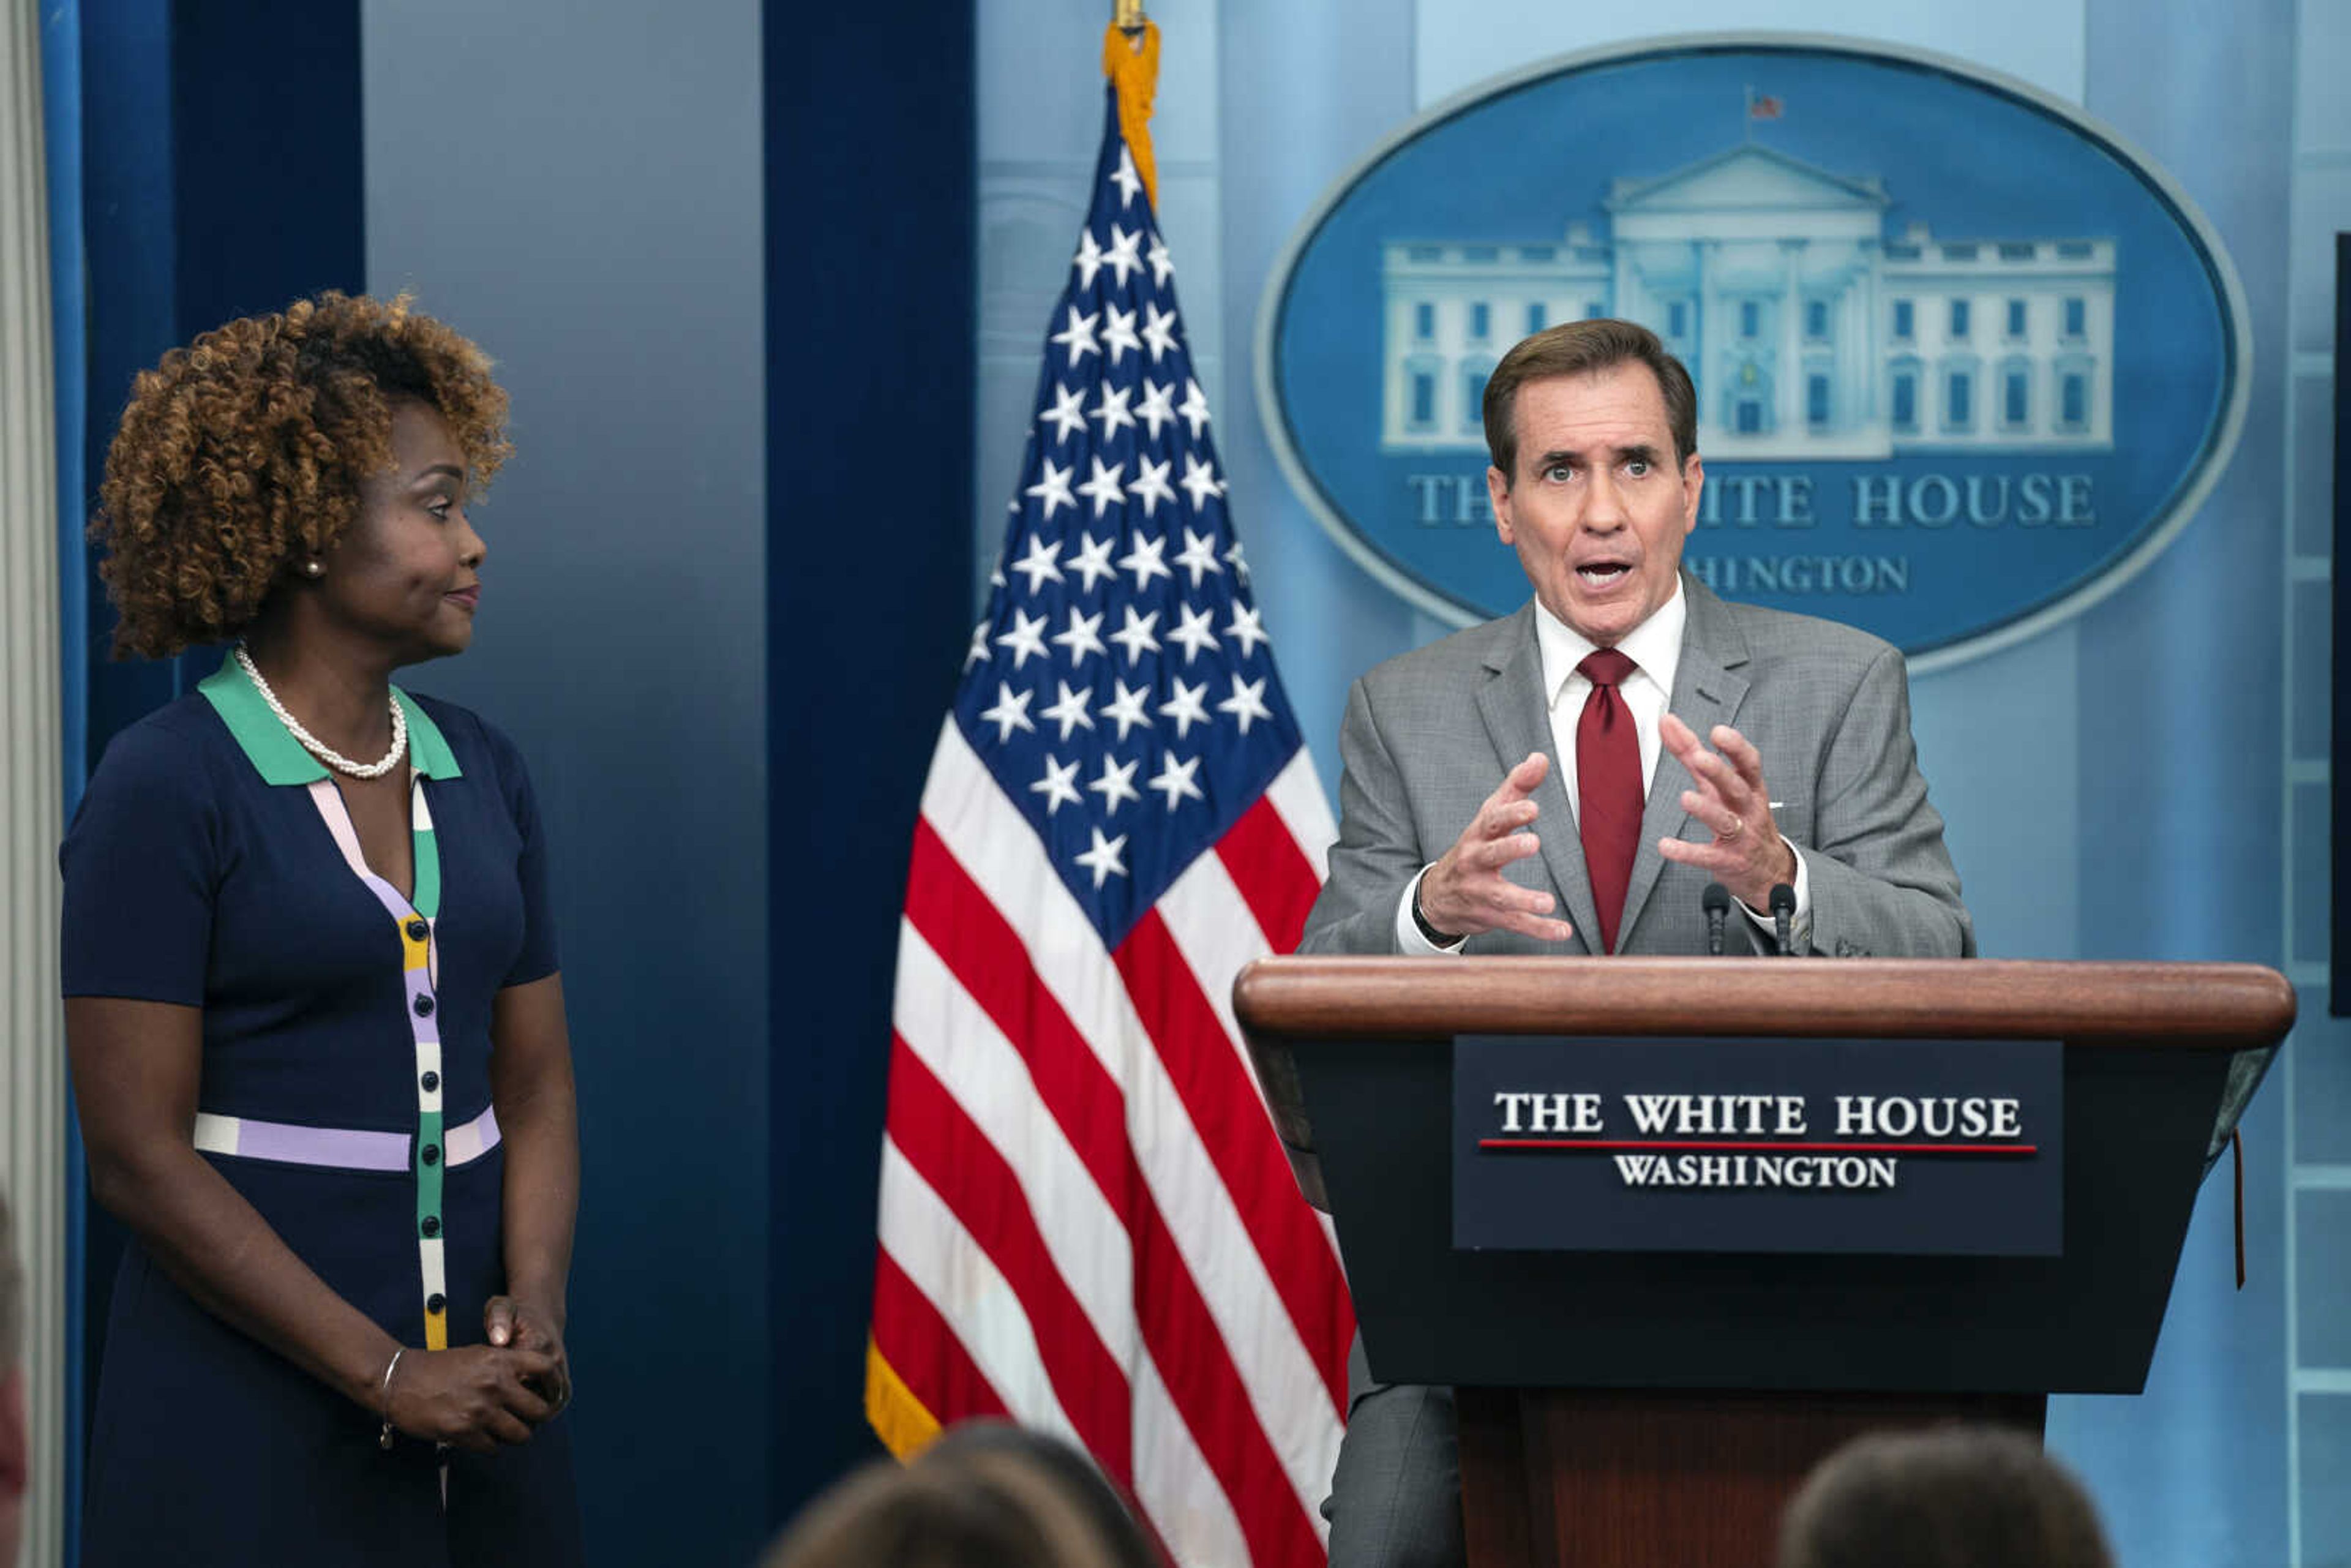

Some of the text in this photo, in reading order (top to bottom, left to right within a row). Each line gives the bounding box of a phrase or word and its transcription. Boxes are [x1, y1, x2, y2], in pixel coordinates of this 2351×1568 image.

[1408, 473, 2094, 527] TH ITE HOUSE
[1687, 555, 1909, 593] HINGTON
[1494, 1092, 2022, 1137] THE WHITE HOUSE
[1613, 1155, 1897, 1187] WASHINGTON
